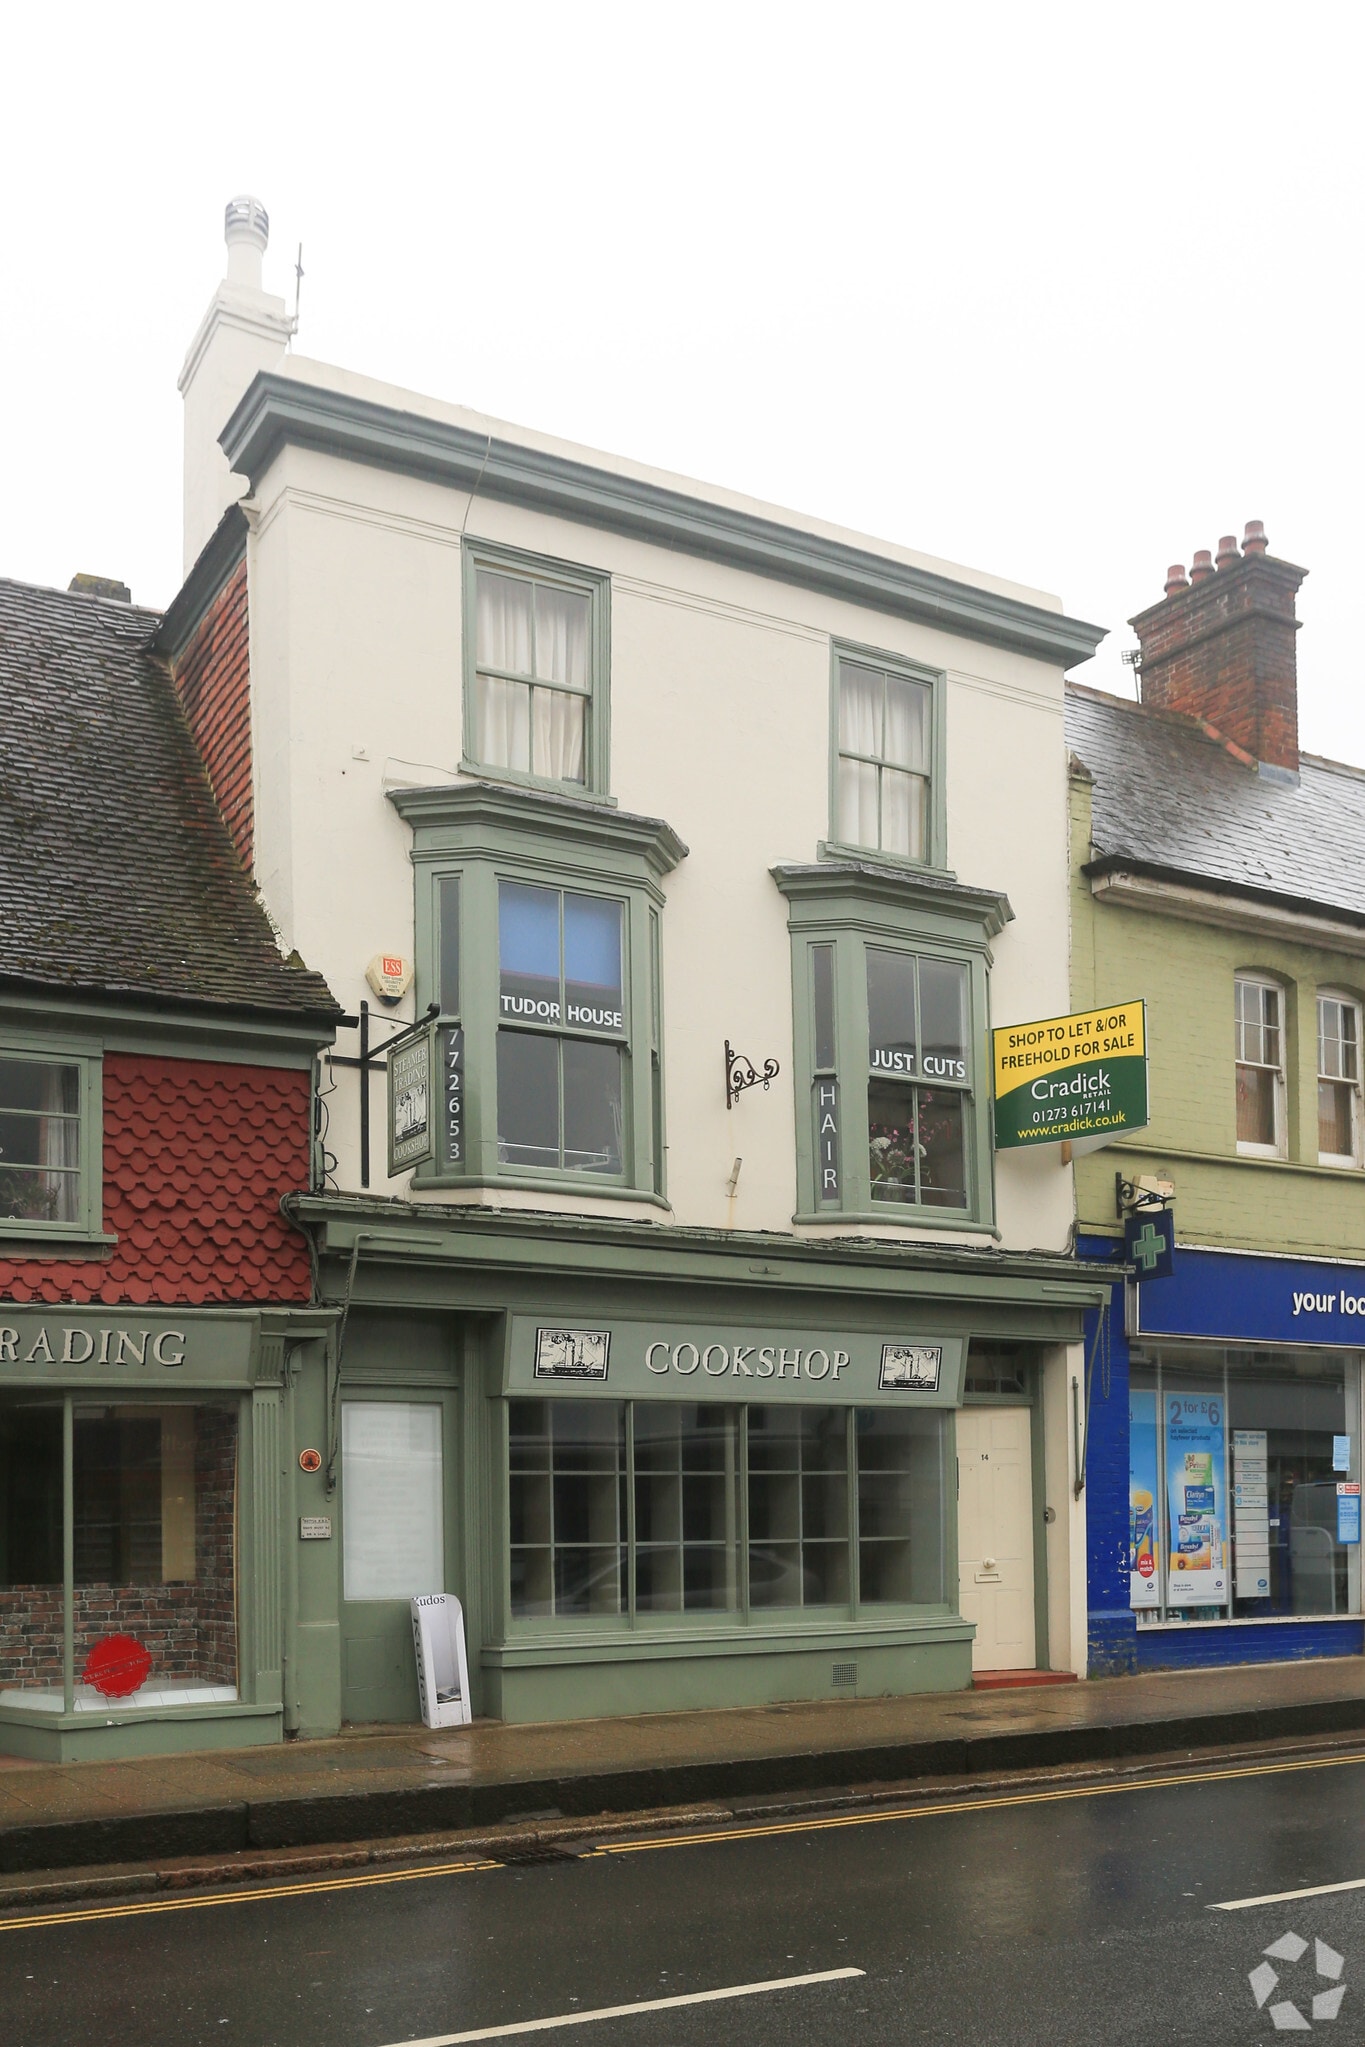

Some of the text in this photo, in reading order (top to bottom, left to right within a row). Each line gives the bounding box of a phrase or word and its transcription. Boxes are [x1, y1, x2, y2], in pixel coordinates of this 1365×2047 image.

[384, 960, 401, 974] ESS
[501, 995, 622, 1028] TUDOR HOUSE
[1008, 1014, 1127, 1048] SHOP TO LET &/OR
[393, 1047, 427, 1077] STEAMER
[872, 1049, 966, 1078] JUST CUTS
[1001, 1033, 1135, 1070] FREEHOLD FOR SALE
[394, 1064, 427, 1092] TRADING
[1031, 1069, 1111, 1100] Cradick
[1082, 1089, 1112, 1099] RETAIL
[1017, 1110, 1126, 1139] www.cradick.co.uk
[1032, 1099, 1111, 1123] 01273 617141
[393, 1134, 429, 1161] COOKSHOP
[820, 1085, 838, 1189] HAIR
[1292, 1291, 1337, 1316] your
[645, 1342, 851, 1381] COOKSHOP
[1170, 1400, 1183, 1425] 2
[1184, 1400, 1198, 1414] for
